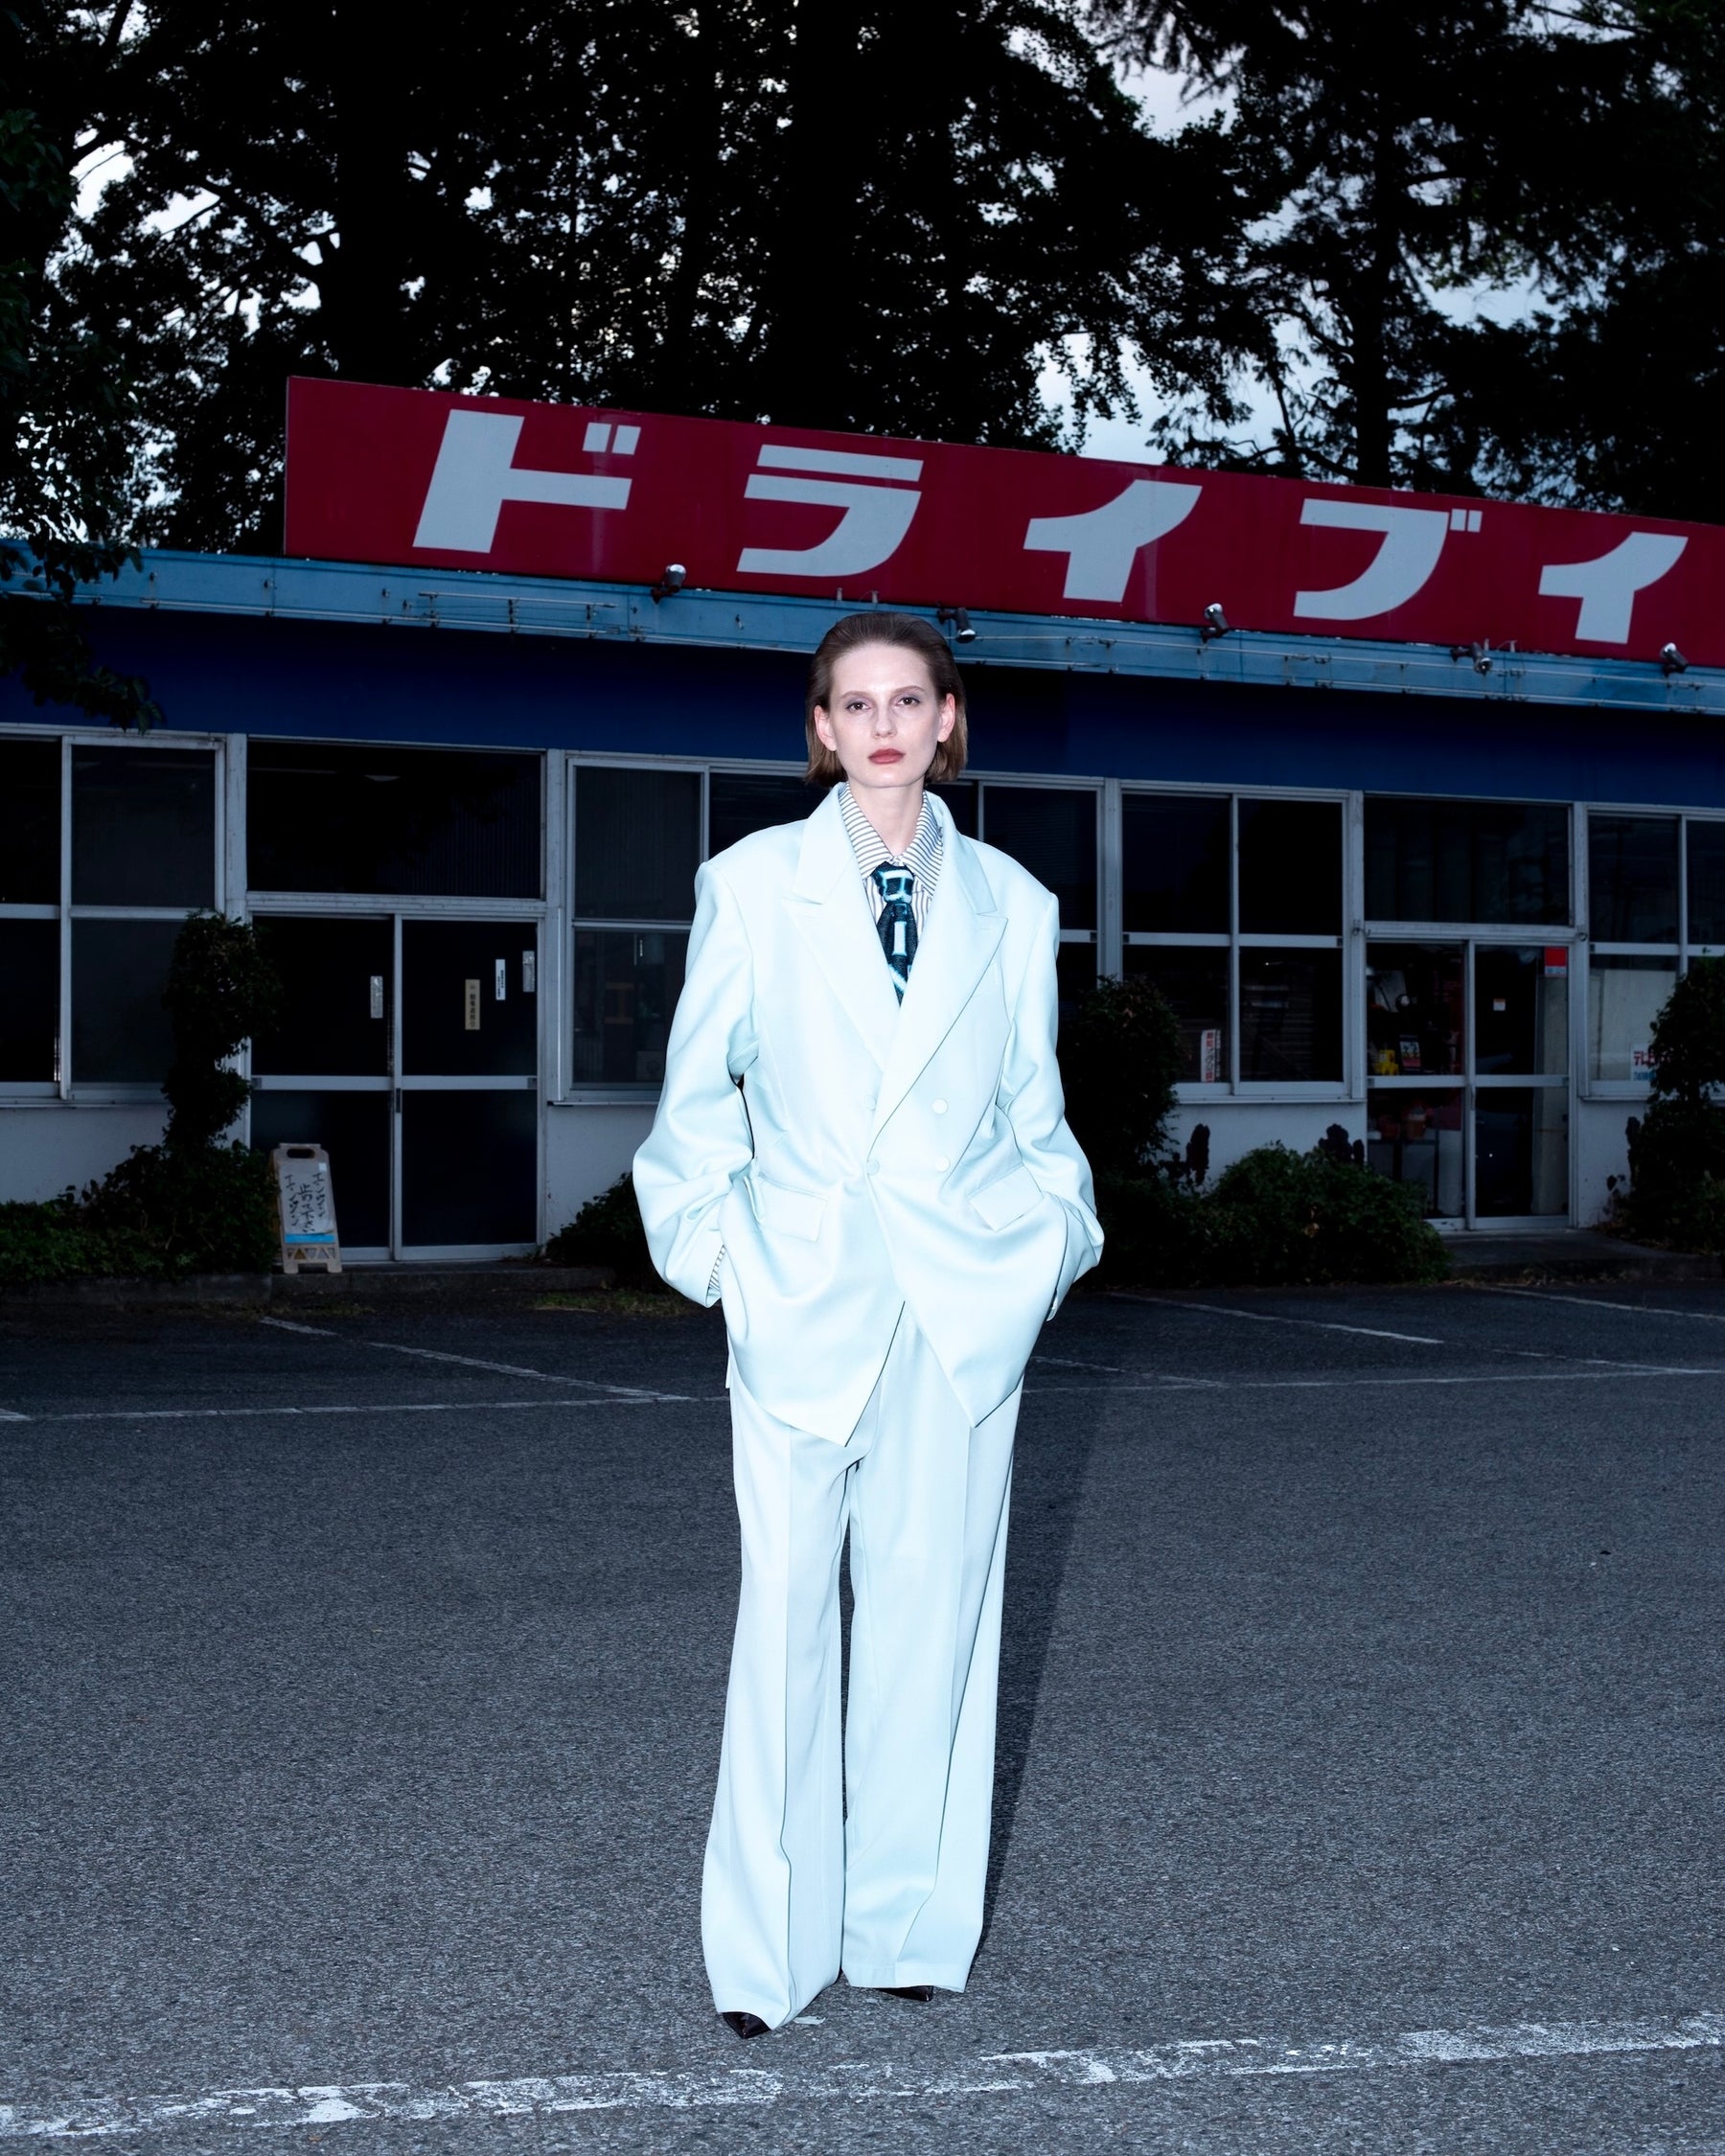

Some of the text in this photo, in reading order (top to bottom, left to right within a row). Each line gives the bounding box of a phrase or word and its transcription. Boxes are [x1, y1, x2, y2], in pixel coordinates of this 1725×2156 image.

[412, 409, 1689, 645] ドライブイ
